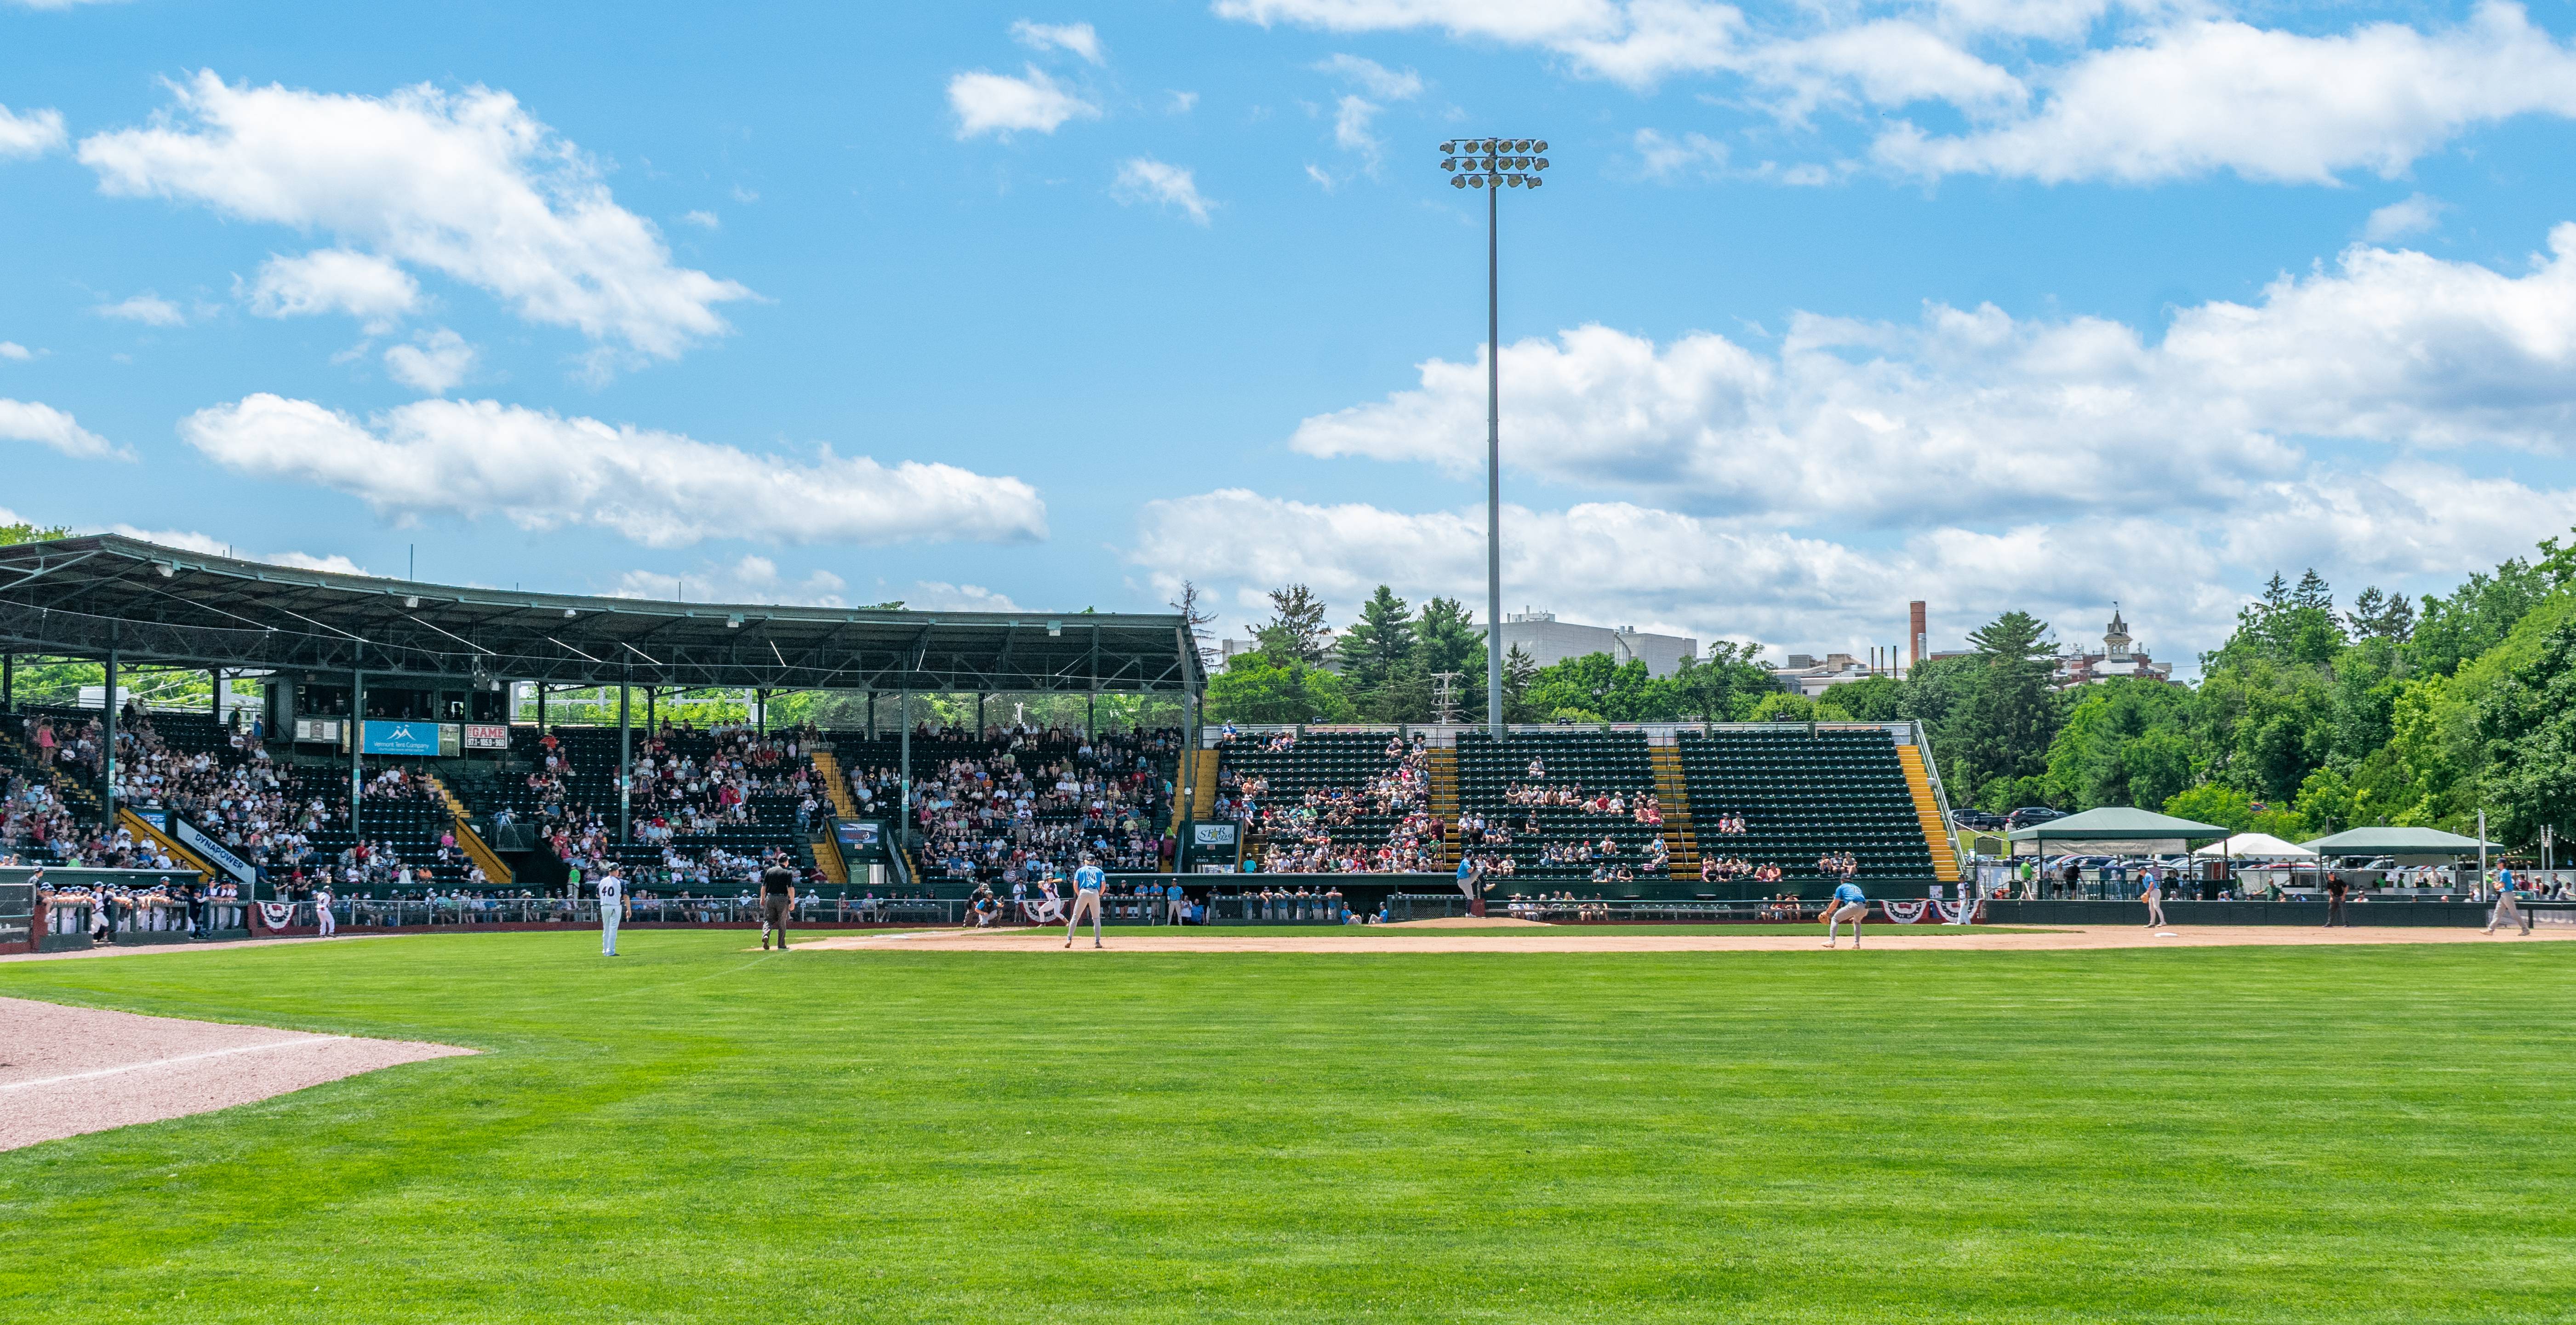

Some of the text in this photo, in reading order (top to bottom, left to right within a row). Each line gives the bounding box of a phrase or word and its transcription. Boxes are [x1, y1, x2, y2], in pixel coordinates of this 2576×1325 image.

[473, 728, 504, 738] GAME
[1200, 827, 1225, 841] STAR
[195, 833, 244, 870] DYNAPOWER
[602, 886, 614, 897] 40
